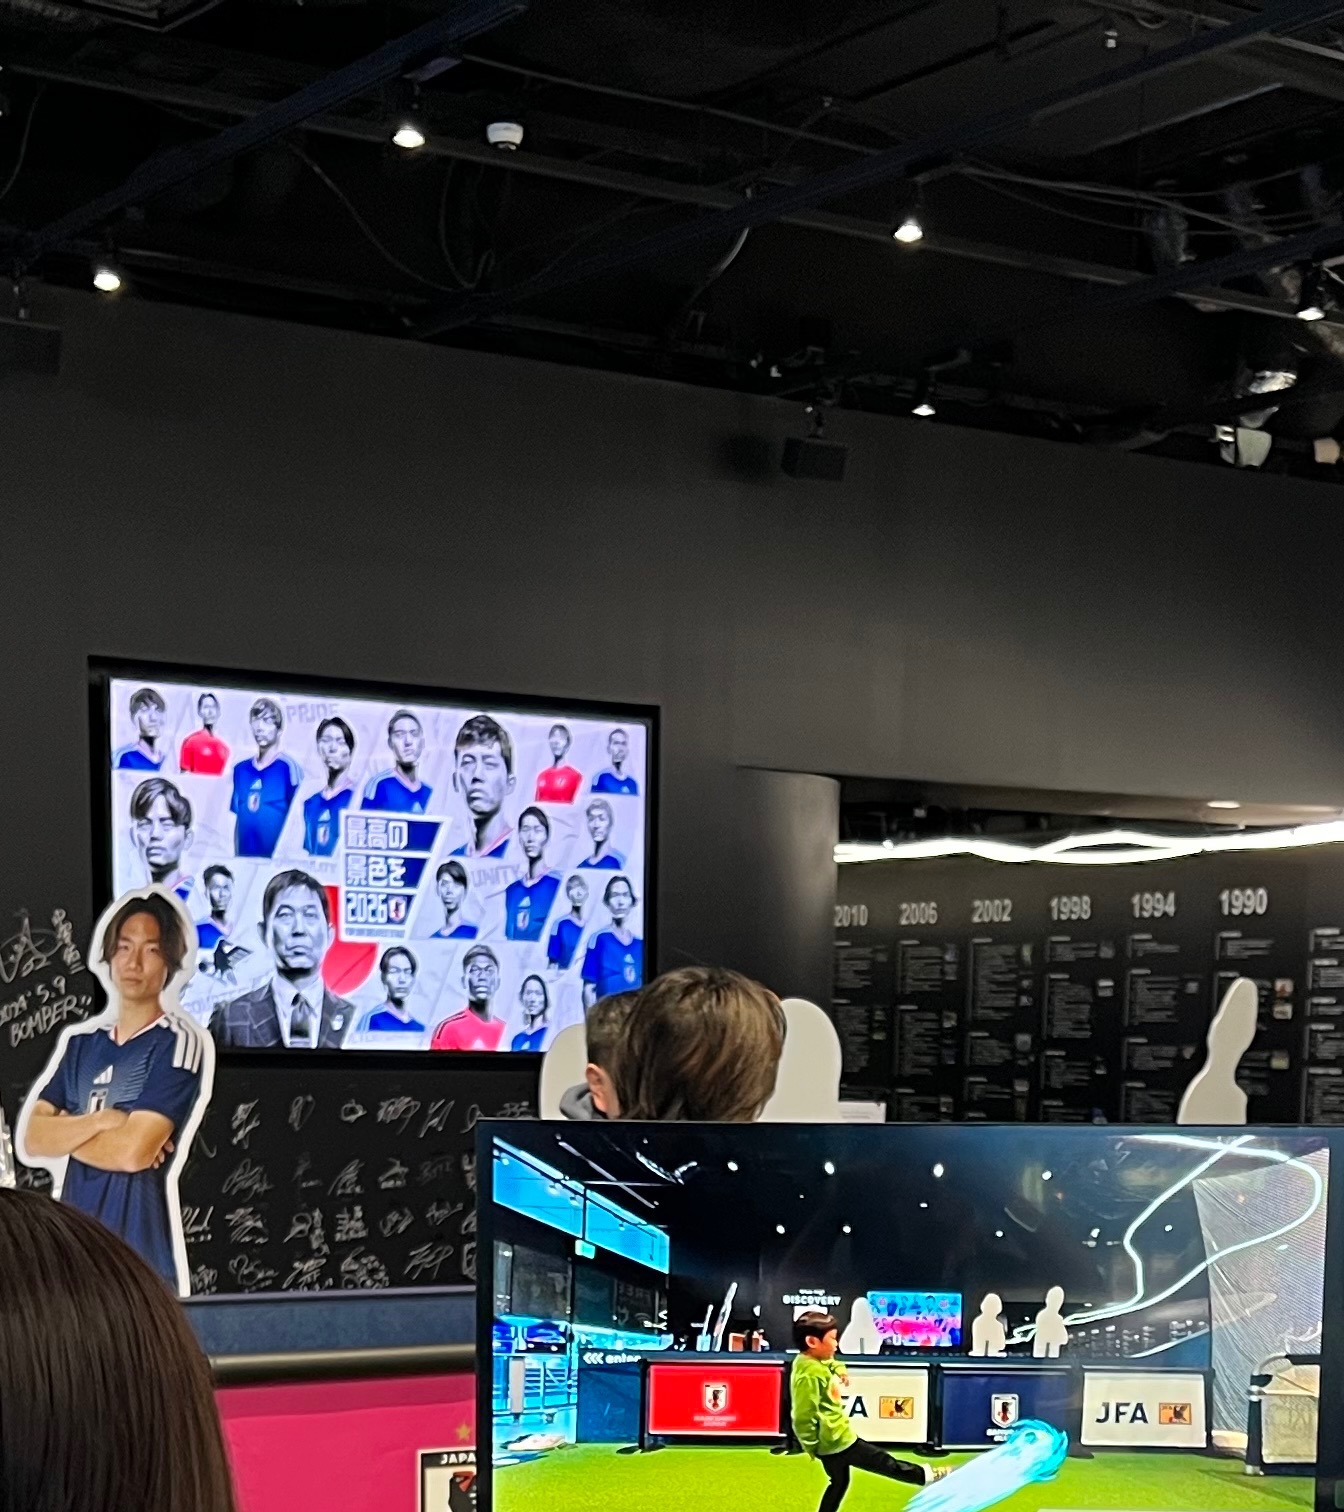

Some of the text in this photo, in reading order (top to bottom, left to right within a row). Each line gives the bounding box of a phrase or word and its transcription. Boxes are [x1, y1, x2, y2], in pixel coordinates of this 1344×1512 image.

[347, 817, 408, 850] 最高の
[347, 854, 406, 886] 景色を
[347, 894, 387, 924] 2026
[899, 902, 938, 925] 2006
[972, 900, 1012, 923] 2002
[1050, 896, 1091, 920] 1998
[1132, 892, 1176, 918] 1994
[1220, 887, 1268, 916] 1990
[834, 905, 868, 926] 2010
[782, 1294, 841, 1306] DISCOVERY
[1096, 1402, 1148, 1424] JFA
